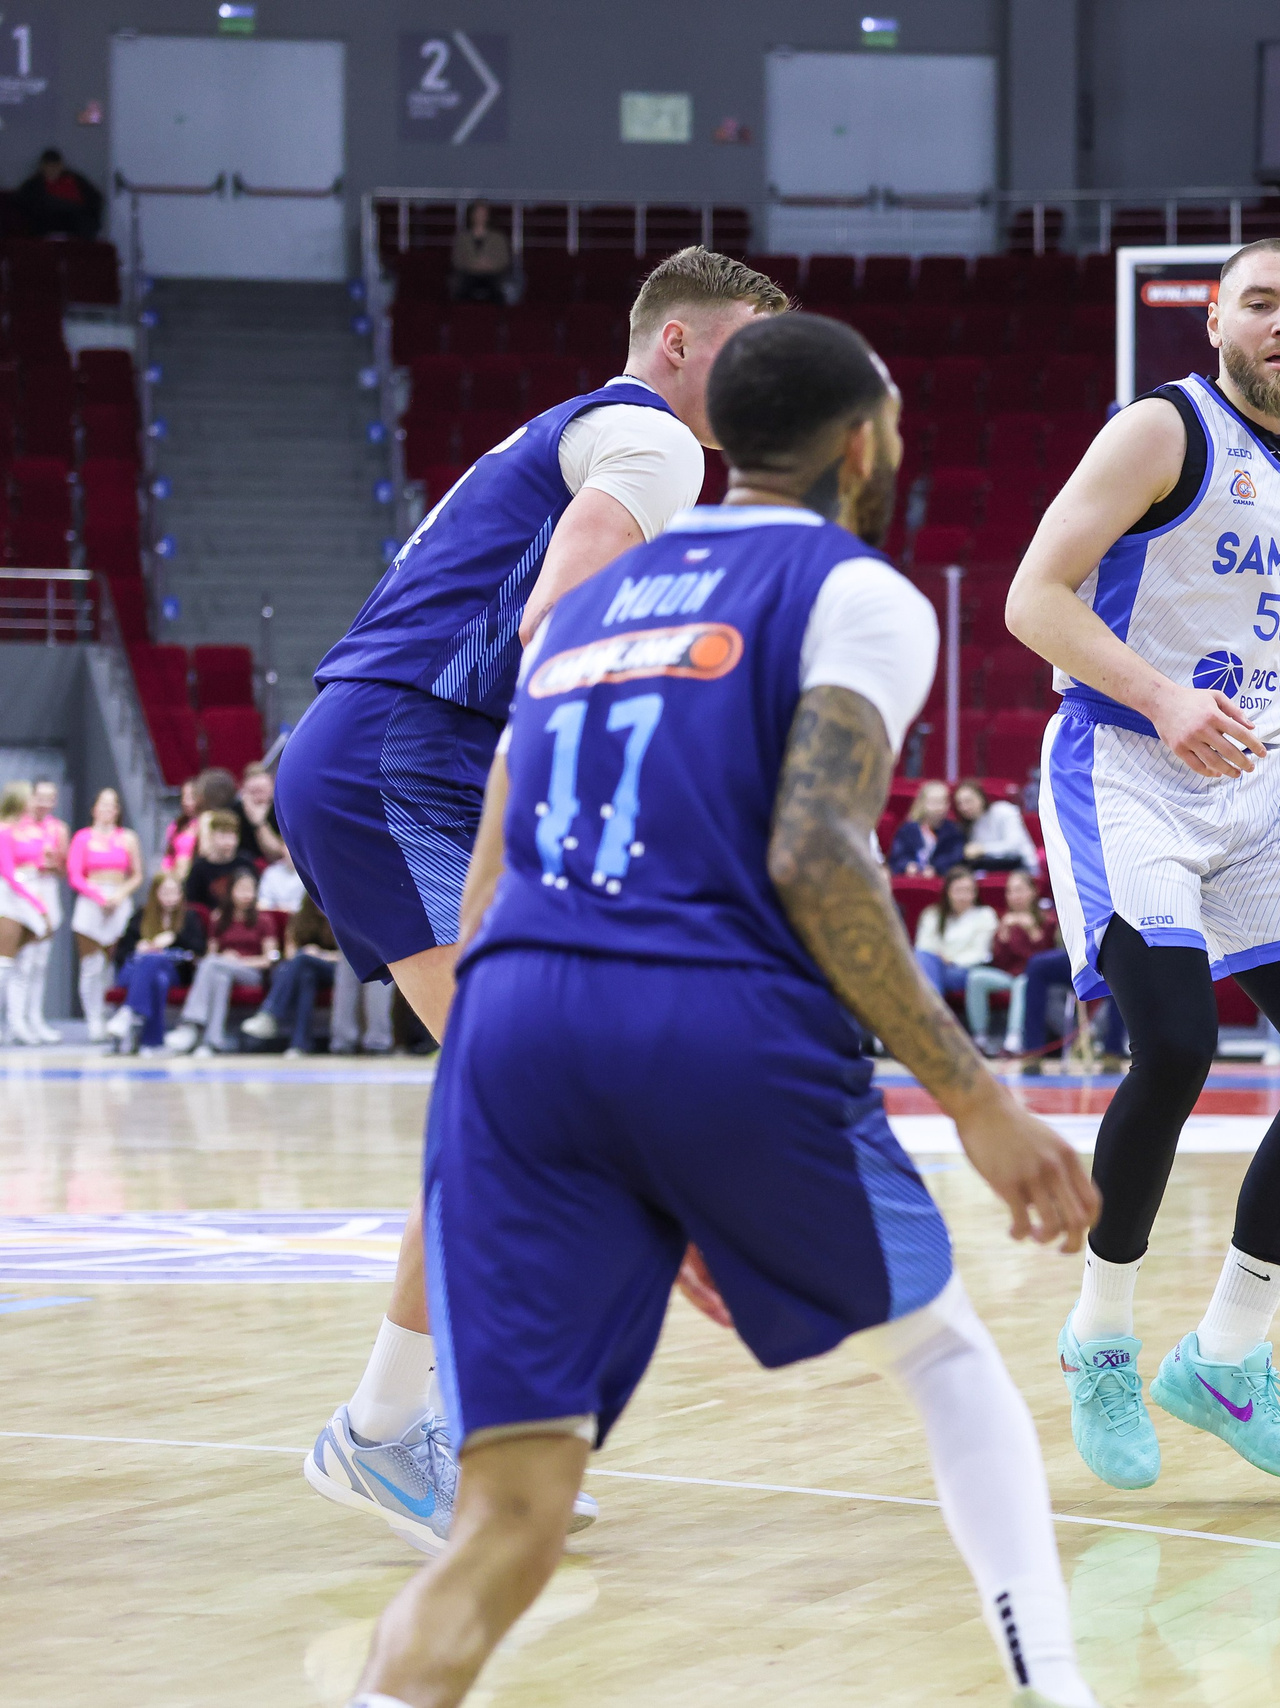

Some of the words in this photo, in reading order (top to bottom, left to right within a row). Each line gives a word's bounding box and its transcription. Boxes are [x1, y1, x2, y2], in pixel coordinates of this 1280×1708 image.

[12, 25, 30, 76] 1
[420, 40, 449, 90] 2
[1226, 447, 1252, 459] ZEDO
[602, 567, 726, 627] MOON
[535, 693, 664, 881] 17
